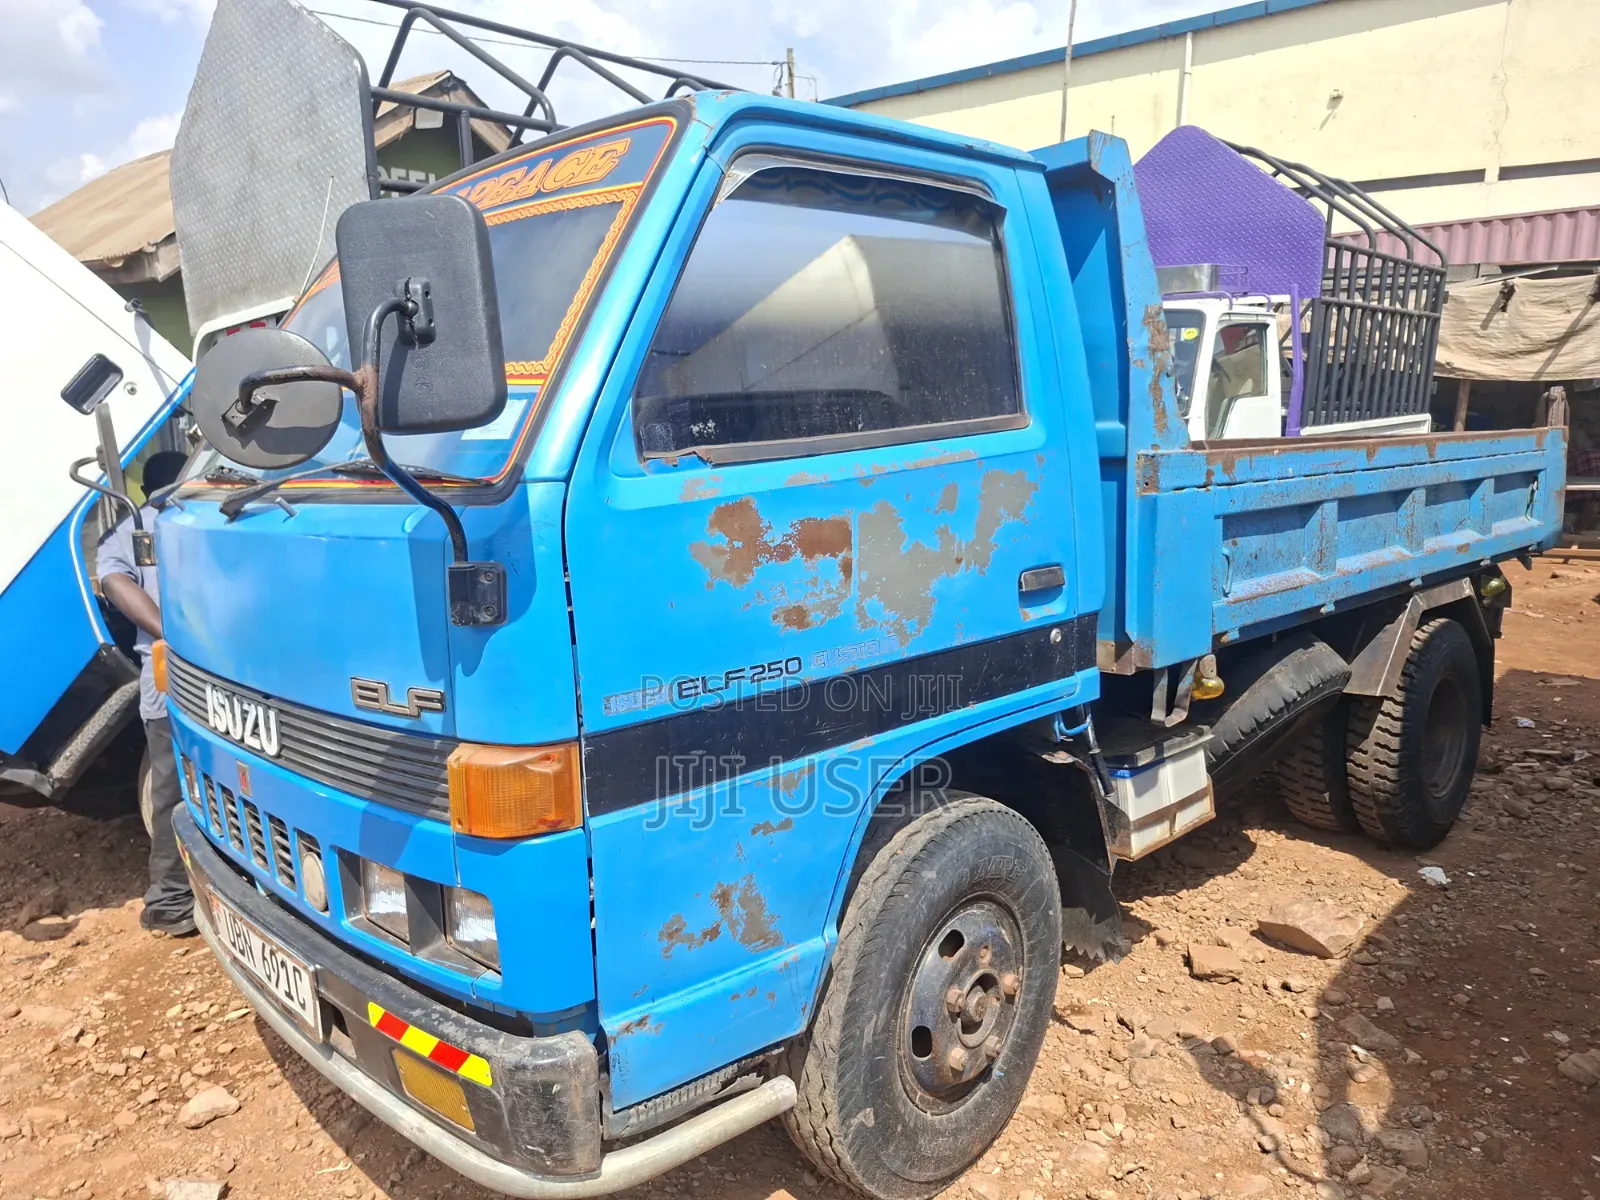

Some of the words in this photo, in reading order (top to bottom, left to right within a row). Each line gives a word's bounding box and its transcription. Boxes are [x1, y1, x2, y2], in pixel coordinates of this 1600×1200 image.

[808, 633, 900, 670] CUSTOM
[205, 683, 281, 757] ISUZU
[351, 677, 446, 719] ELF
[261, 942, 307, 1011] 691C
